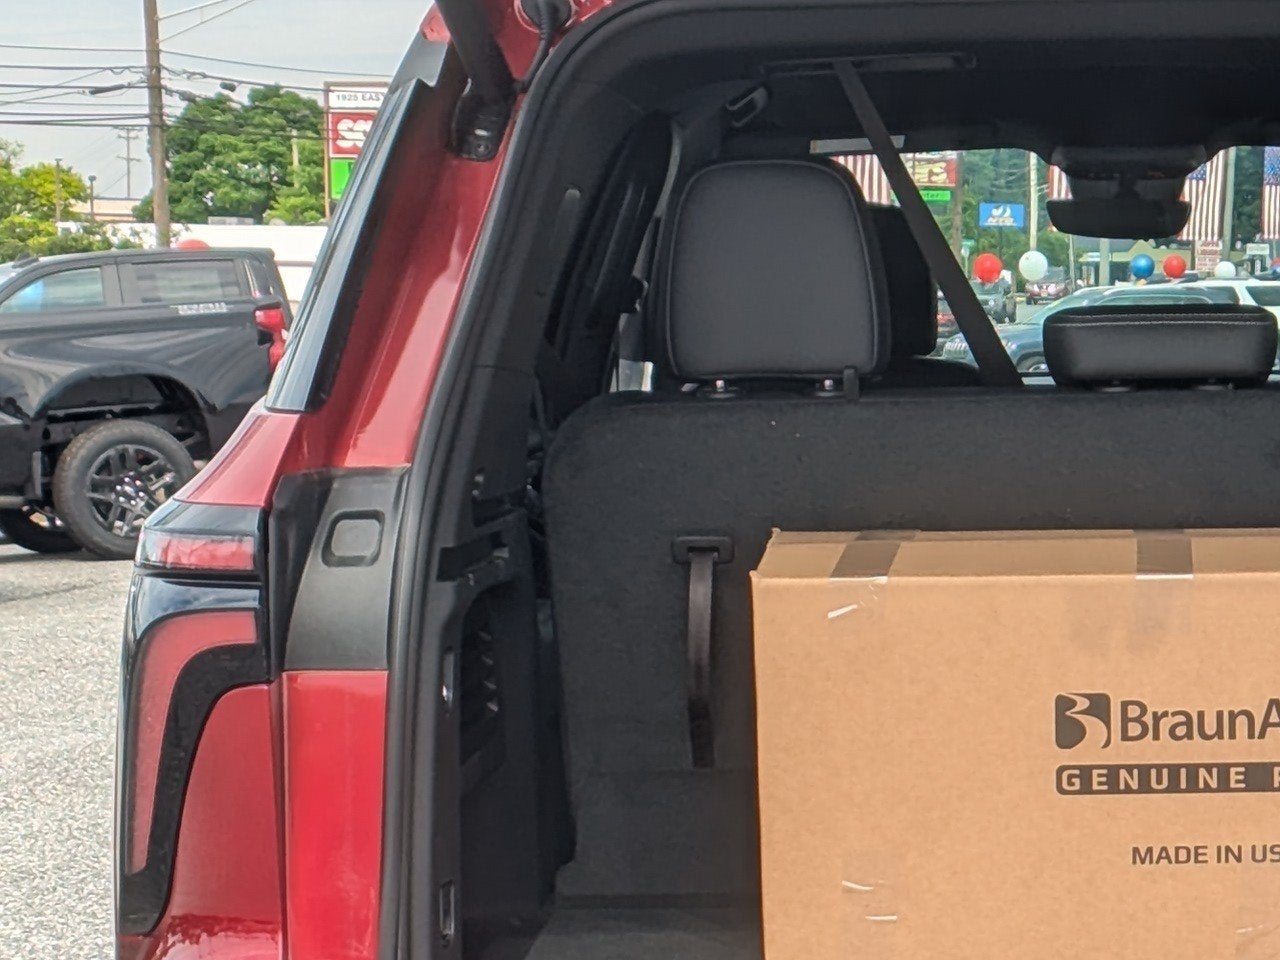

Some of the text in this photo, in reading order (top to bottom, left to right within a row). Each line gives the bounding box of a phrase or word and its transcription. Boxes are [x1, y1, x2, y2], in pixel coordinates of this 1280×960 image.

[361, 92, 384, 101] EAS
[1060, 766, 1247, 791] GENUINE
[1131, 845, 1209, 865] MADE
[1216, 844, 1243, 864] IN
